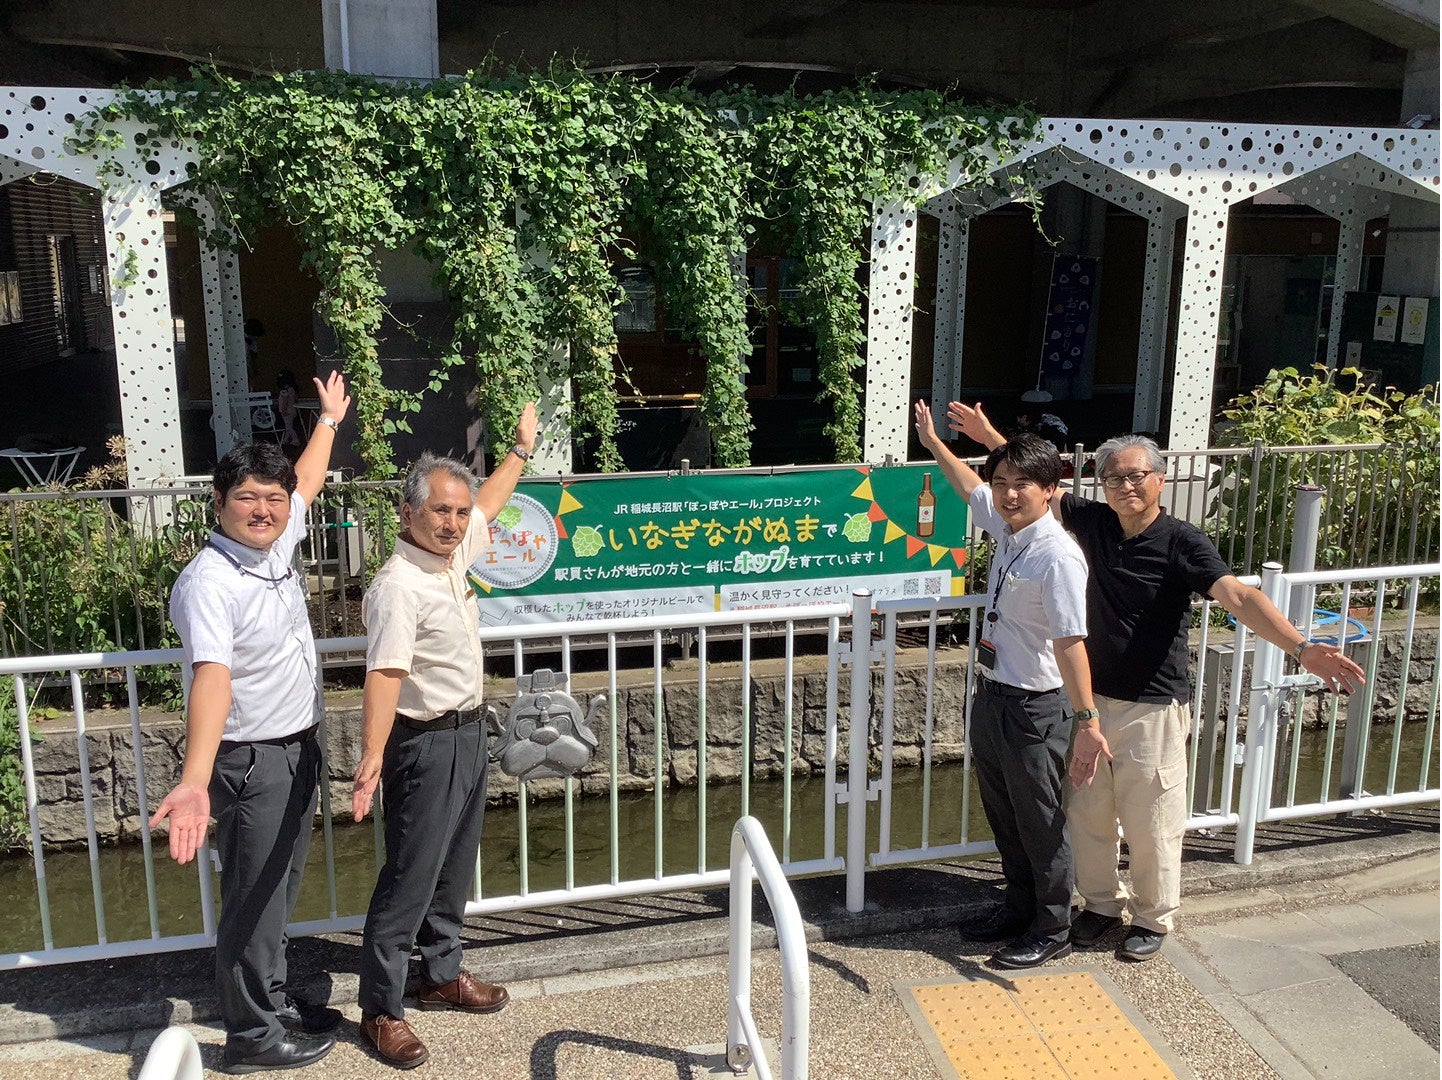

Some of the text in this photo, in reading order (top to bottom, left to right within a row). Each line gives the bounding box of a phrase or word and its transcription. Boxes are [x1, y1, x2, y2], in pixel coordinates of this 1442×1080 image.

[614, 503, 628, 515] JR
[609, 514, 838, 550] いなぎながぬまで
[486, 549, 536, 564] エール
[729, 584, 849, 602] 温かく見守ってください！
[513, 595, 704, 615] 収穫したホップを使ったオリジナルビールで
